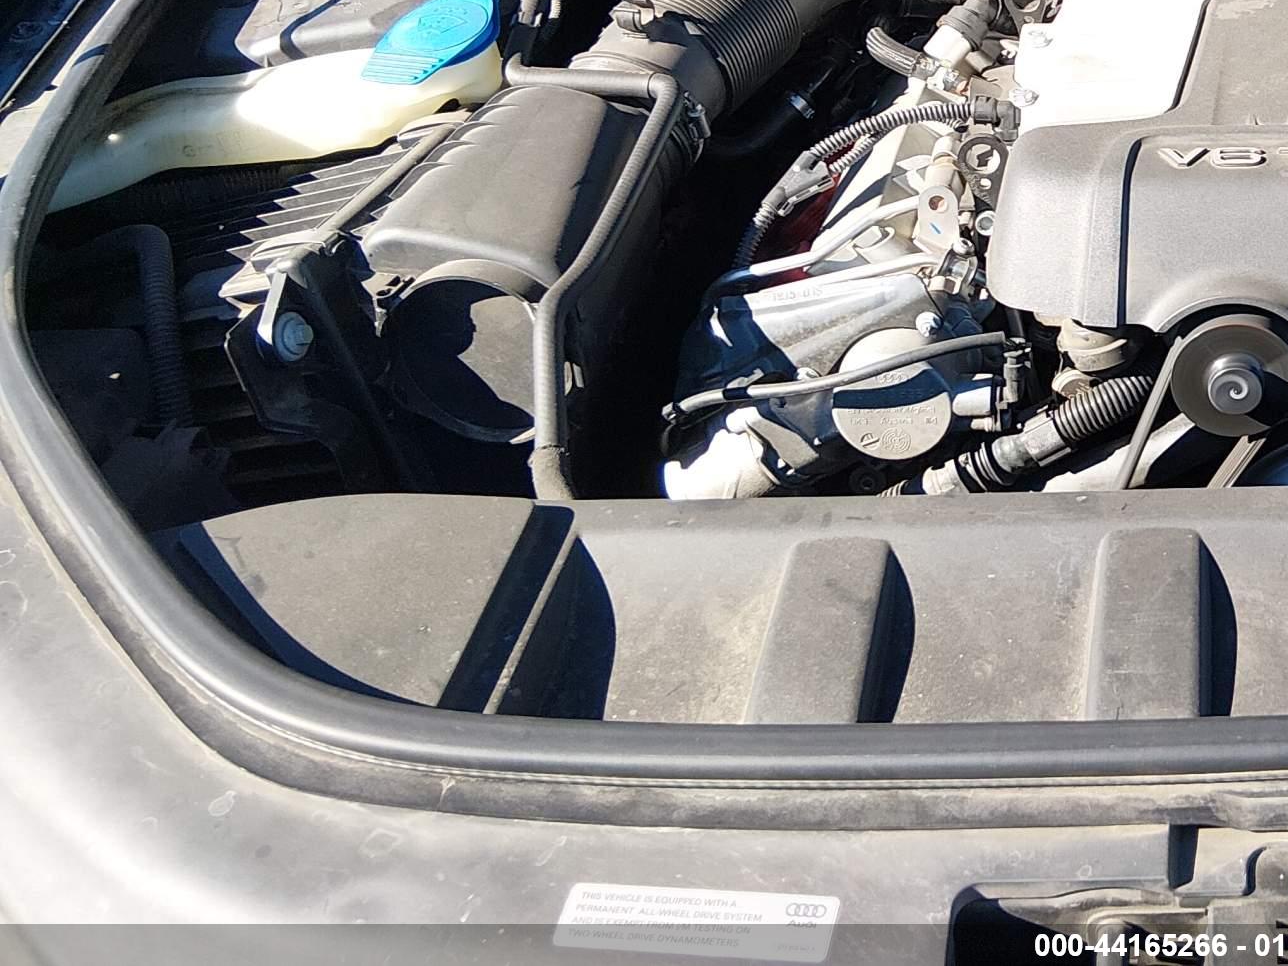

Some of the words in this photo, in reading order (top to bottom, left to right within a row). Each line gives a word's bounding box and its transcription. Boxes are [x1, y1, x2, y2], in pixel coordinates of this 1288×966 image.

[1158, 145, 1267, 168] V6
[581, 891, 602, 901] THIS
[603, 892, 642, 903] VEHICLE
[643, 895, 654, 904] IS
[654, 896, 702, 906] EQUIPPED
[703, 898, 730, 908] WITH
[728, 900, 738, 908] A
[575, 903, 635, 915] PERMANENT
[693, 910, 721, 921] DRIVE
[723, 912, 763, 923] SYSTEM
[571, 916, 594, 925] AND
[594, 916, 605, 925] IS
[604, 917, 644, 928] EXEMPT
[645, 919, 674, 931] FROM
[693, 923, 735, 934] TESTING
[735, 925, 752, 935] ON
[785, 919, 817, 929] Audi
[626, 931, 655, 943] DRIVE
[656, 933, 741, 948] DYNAMOMETERS
